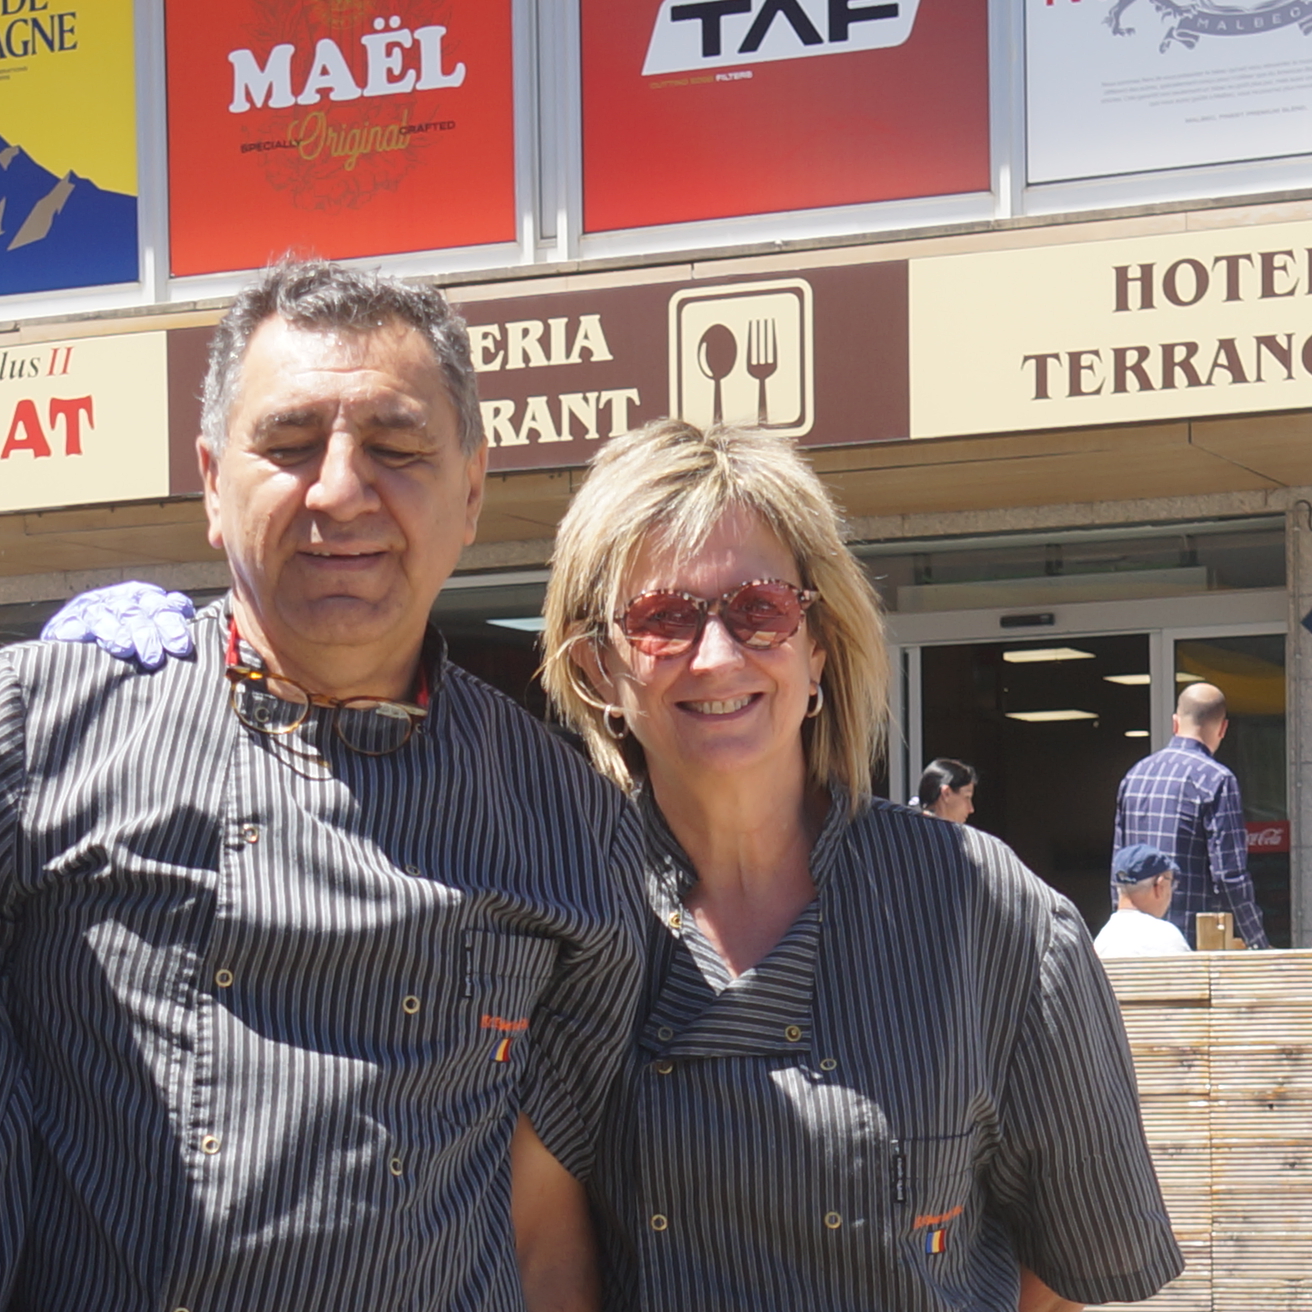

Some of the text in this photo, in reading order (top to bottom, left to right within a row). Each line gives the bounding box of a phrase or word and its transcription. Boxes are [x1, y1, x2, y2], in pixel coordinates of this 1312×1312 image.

[1196, 7, 1302, 31] MALBEC
[228, 15, 466, 113] MAËL
[240, 108, 456, 172] SPECIALLY Original CRAFTED
[46, 346, 75, 376] II
[467, 313, 614, 373] ERIA
[479, 387, 641, 448] RANT
